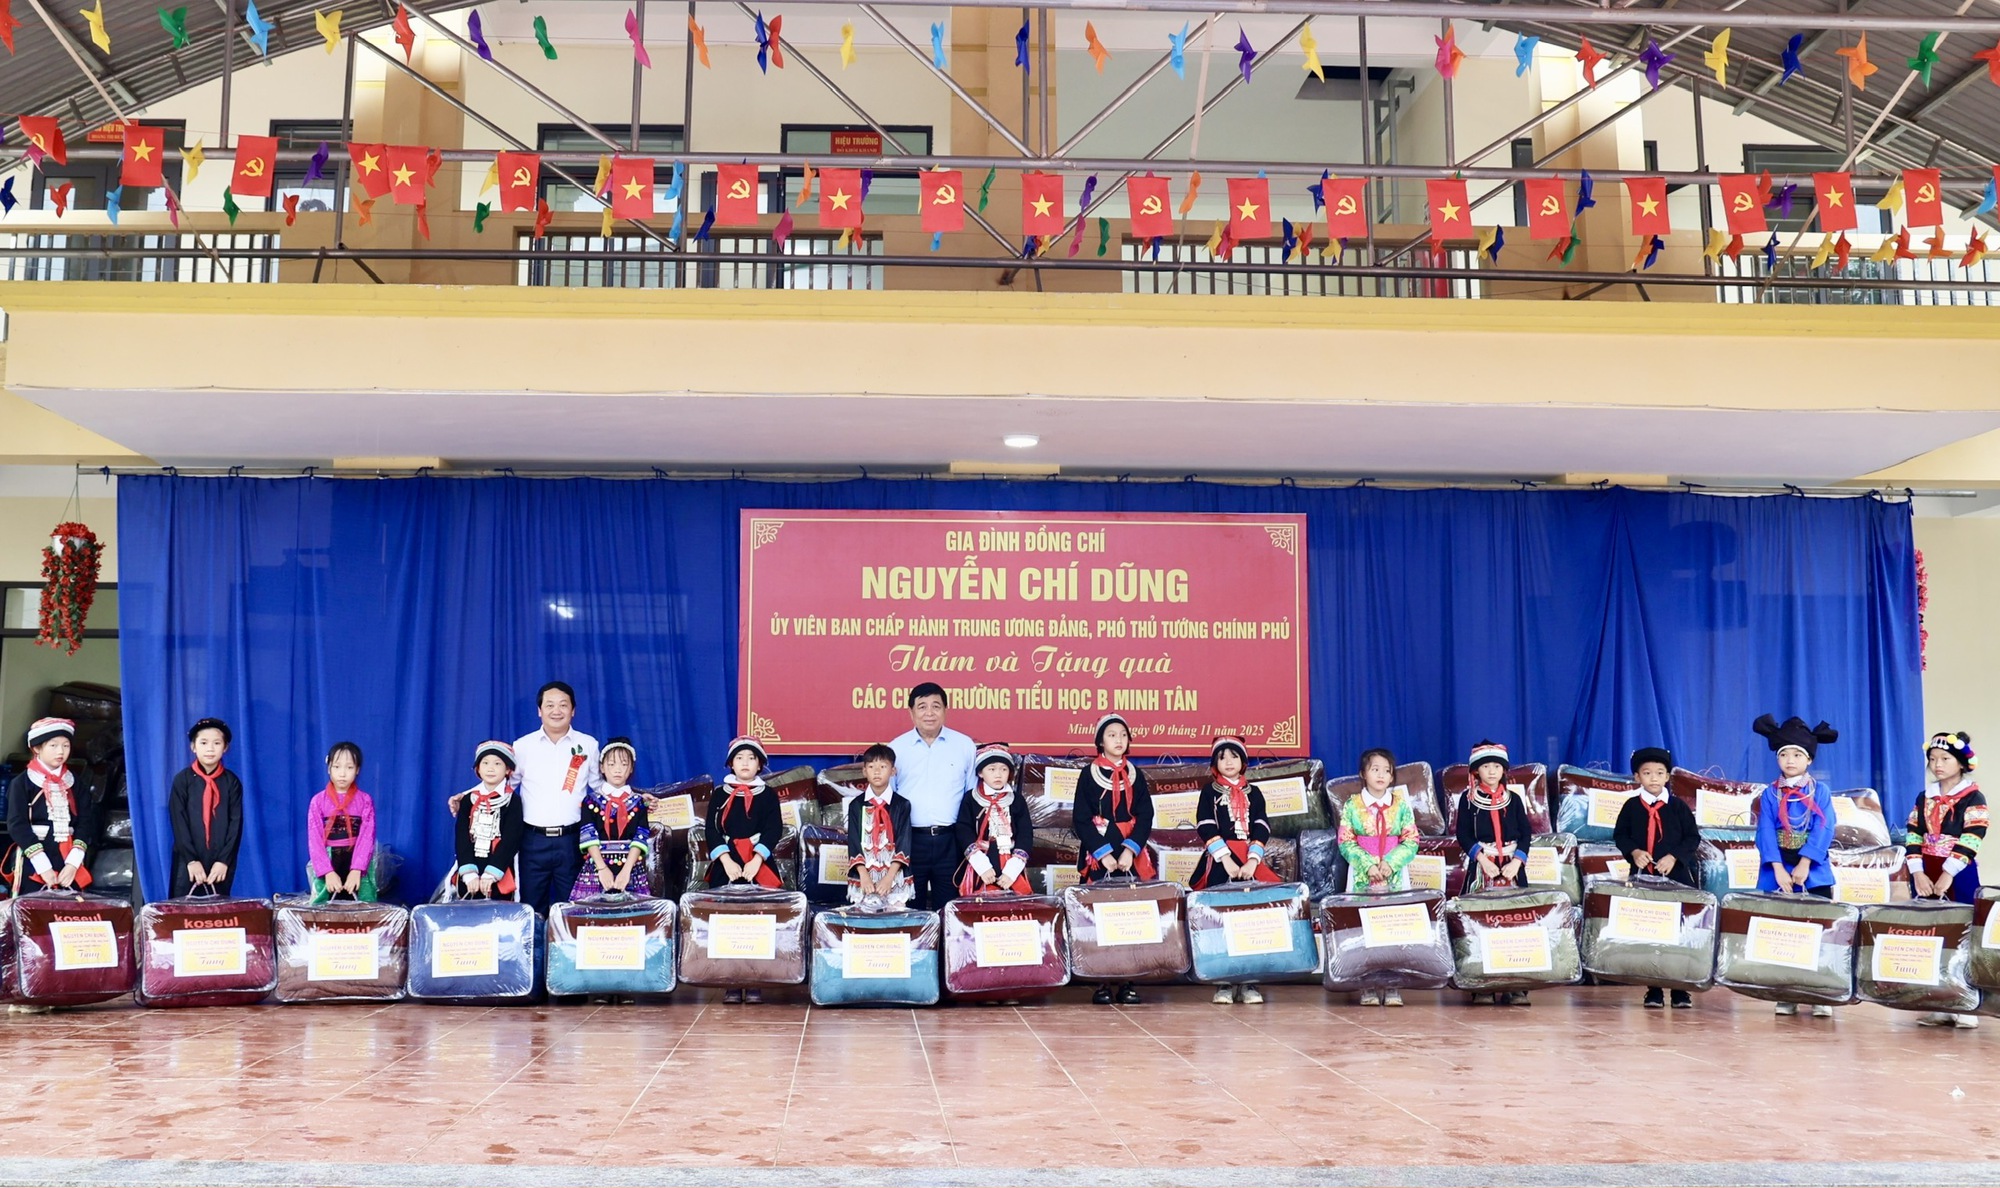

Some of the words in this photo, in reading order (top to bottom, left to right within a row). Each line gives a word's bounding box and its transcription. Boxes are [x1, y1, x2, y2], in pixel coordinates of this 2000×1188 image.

[835, 136, 851, 147] HIỆU
[945, 530, 975, 552] GIA
[978, 526, 1020, 552] ĐÌNH
[1025, 524, 1072, 552] ĐỒNG
[1077, 527, 1105, 553] CHÍ
[862, 554, 1007, 601] NGUYỄN
[1019, 560, 1079, 602] CHÍ
[1091, 561, 1189, 603] DŨNG
[770, 611, 790, 636] ỦY
[793, 614, 827, 636] VIÊN
[830, 618, 862, 636] BAN
[865, 612, 905, 637] CHẤP
[908, 613, 951, 638] HÀNH
[952, 617, 1001, 637] TRUNG
[1004, 617, 1046, 638] ƯƠNG
[1047, 613, 1093, 641] ĐẢNG,
[1096, 615, 1127, 638] PHÓ
[1130, 615, 1158, 639] THỦ
[1161, 614, 1209, 639] TƯỚNG
[1212, 616, 1258, 640] CHÍNH
[1261, 616, 1290, 640] PHỦ
[889, 644, 976, 673] Thăm
[986, 651, 1020, 673] và
[1031, 645, 1110, 680] Tặng
[1119, 652, 1173, 680] quà
[852, 683, 887, 709] CÁC
[945, 683, 1011, 710] TRƯỜNG
[1015, 680, 1053, 710] TIỂU
[1058, 688, 1092, 714] HỌC
[1097, 688, 1109, 710] B
[1114, 689, 1160, 711] MINH
[1164, 685, 1197, 711] TÂN
[1067, 723, 1095, 735] Minh
[1152, 724, 1165, 735] 09
[1167, 724, 1198, 738] tháng
[1200, 724, 1211, 736] 11
[1214, 724, 1237, 736] năm
[1240, 725, 1264, 736] 2025
[1156, 780, 1199, 791] koseul
[184, 916, 239, 929] koseul
[1485, 910, 1537, 924] koseul
